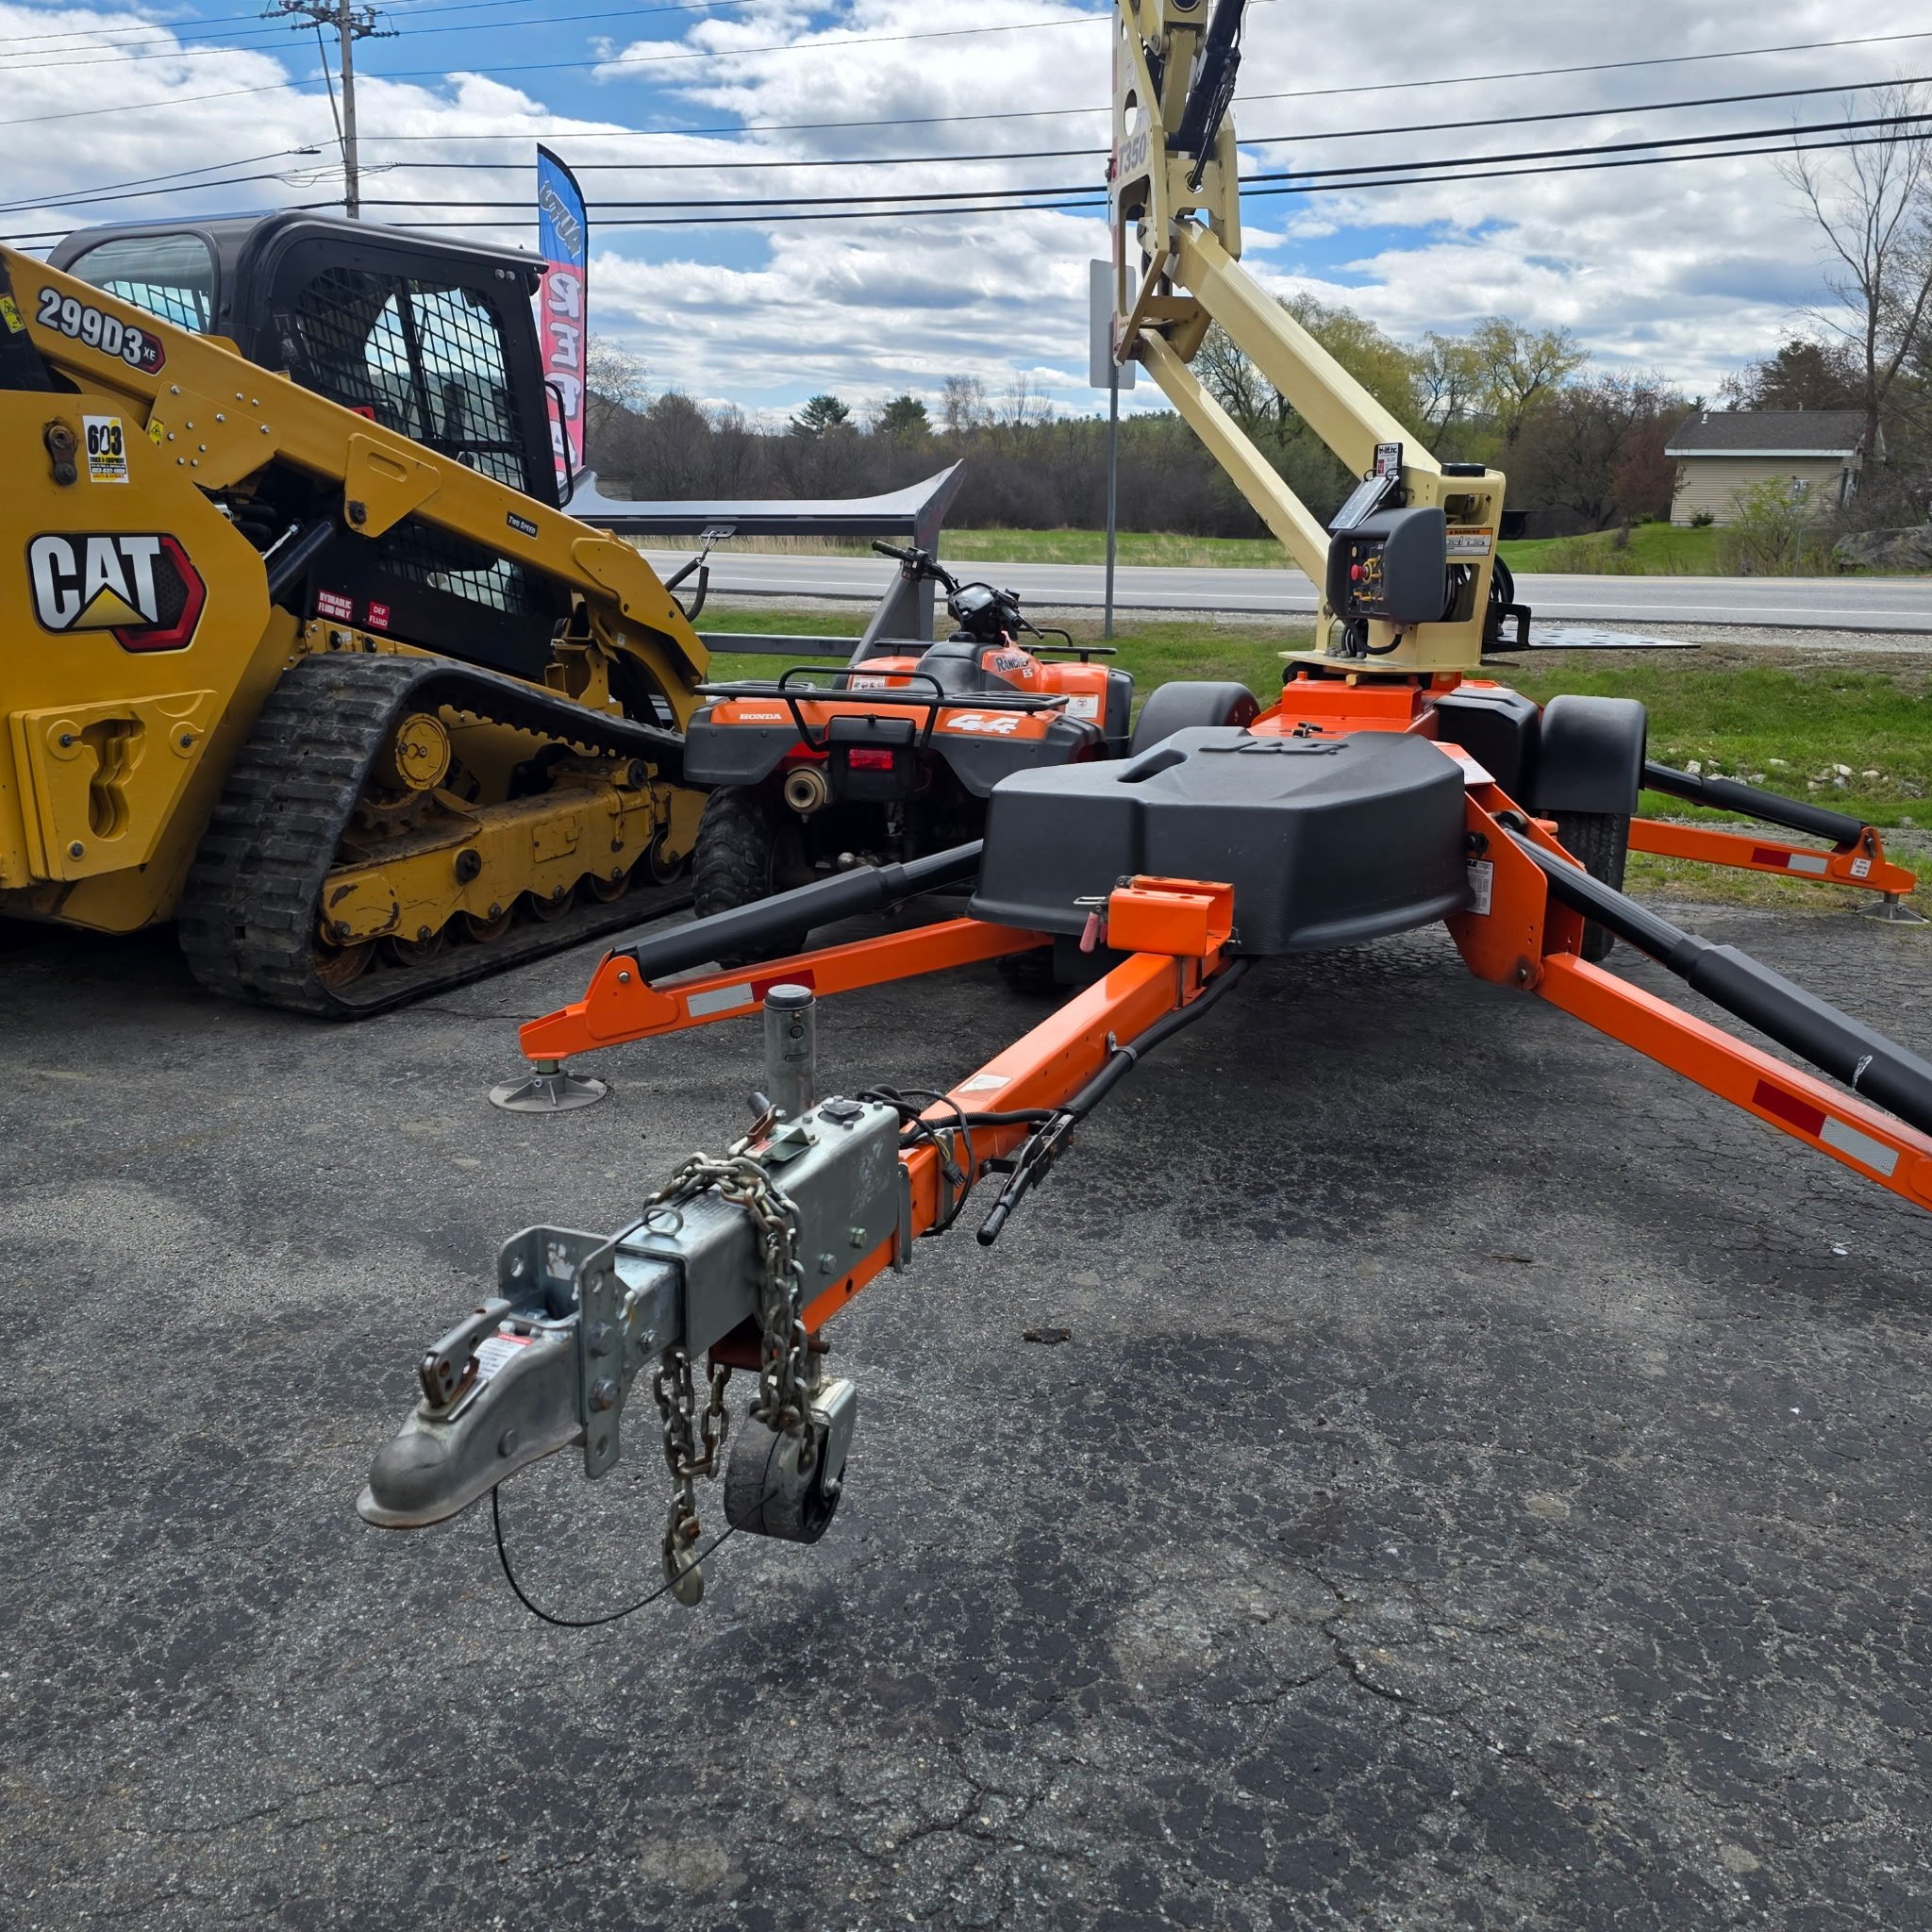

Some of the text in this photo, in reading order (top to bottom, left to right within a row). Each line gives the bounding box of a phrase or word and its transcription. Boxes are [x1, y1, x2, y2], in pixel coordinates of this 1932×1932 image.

[1119, 132, 1147, 177] T350
[38, 288, 156, 364] 299D3 XE
[88, 425, 123, 456] 603
[29, 536, 160, 629] CAT
[319, 591, 352, 609] HYDRAULIC
[319, 602, 351, 620] FLUID ONLY
[374, 606, 386, 615] DEF
[369, 615, 388, 626] FLUID
